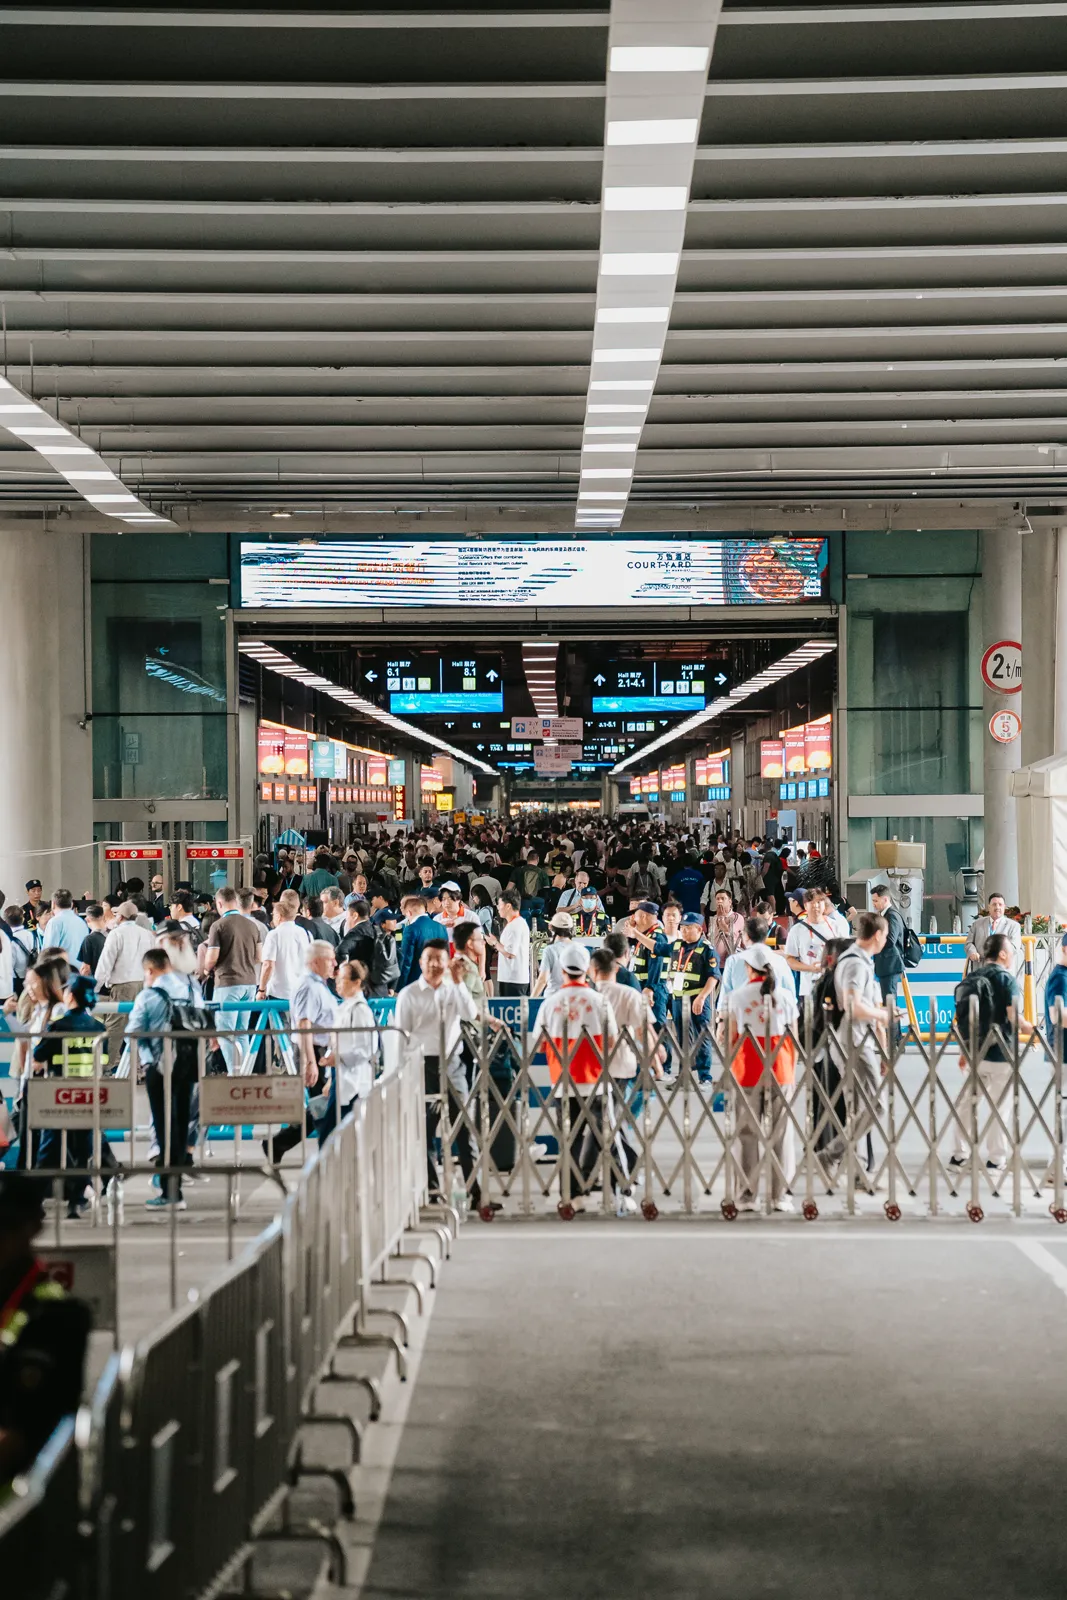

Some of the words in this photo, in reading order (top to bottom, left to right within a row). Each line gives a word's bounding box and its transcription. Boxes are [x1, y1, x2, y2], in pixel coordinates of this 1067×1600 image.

[387, 668, 399, 676] 6.1
[464, 668, 476, 676] 8.1
[681, 671, 693, 680] 1.1
[618, 679, 645, 688] 2.1-4.1
[1002, 721, 1010, 732] 5
[920, 944, 953, 954] OLICE
